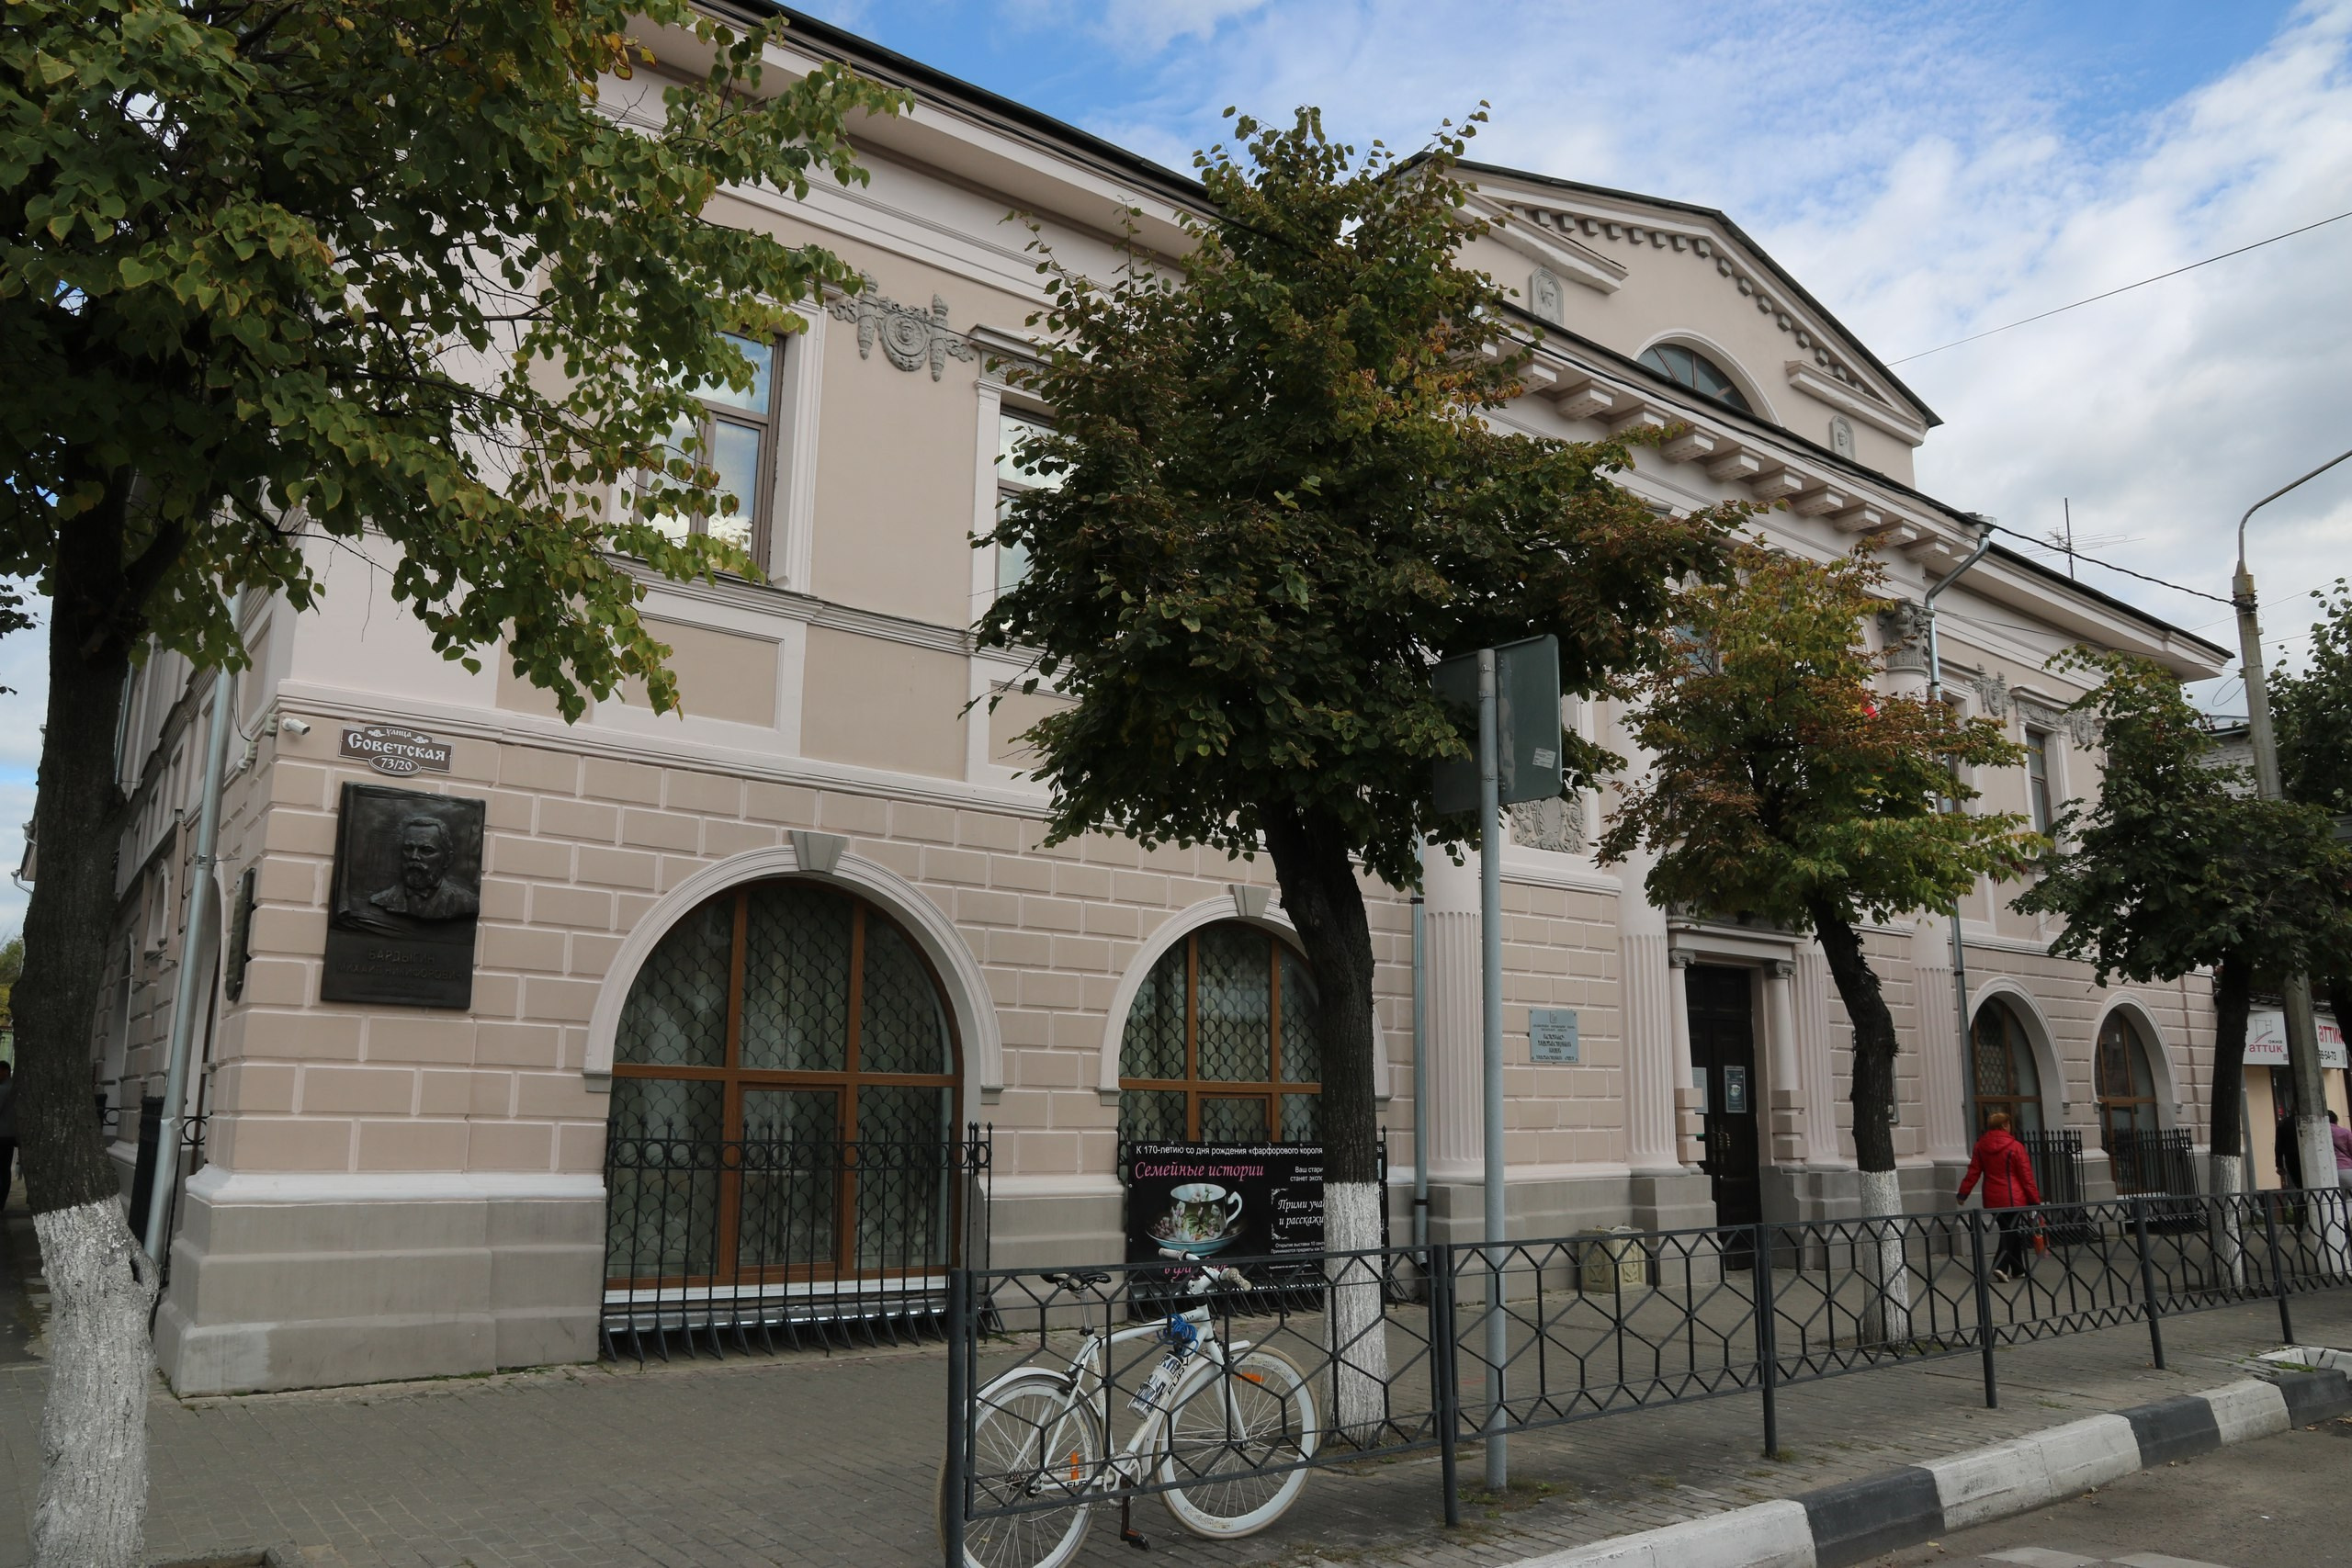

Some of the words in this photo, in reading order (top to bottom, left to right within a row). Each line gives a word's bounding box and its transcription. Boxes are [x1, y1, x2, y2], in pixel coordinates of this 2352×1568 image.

[348, 732, 446, 761] Советская
[380, 758, 413, 771] 73/20
[368, 948, 435, 964] БАРДЫГИН
[2249, 1043, 2283, 1053] аттик
[1136, 1145, 1142, 1155] К
[1144, 1145, 1184, 1155] 170-летию
[1196, 1147, 1209, 1156] дня
[1211, 1147, 1247, 1156] рождения
[1248, 1146, 1299, 1156] «фарфорового
[1300, 1147, 1323, 1156] короля
[1135, 1161, 1204, 1179] Семейные
[1208, 1164, 1264, 1181] истории
[1277, 1198, 1307, 1213] Прими
[1308, 1200, 1324, 1212] уча
[1279, 1217, 1284, 1225] и
